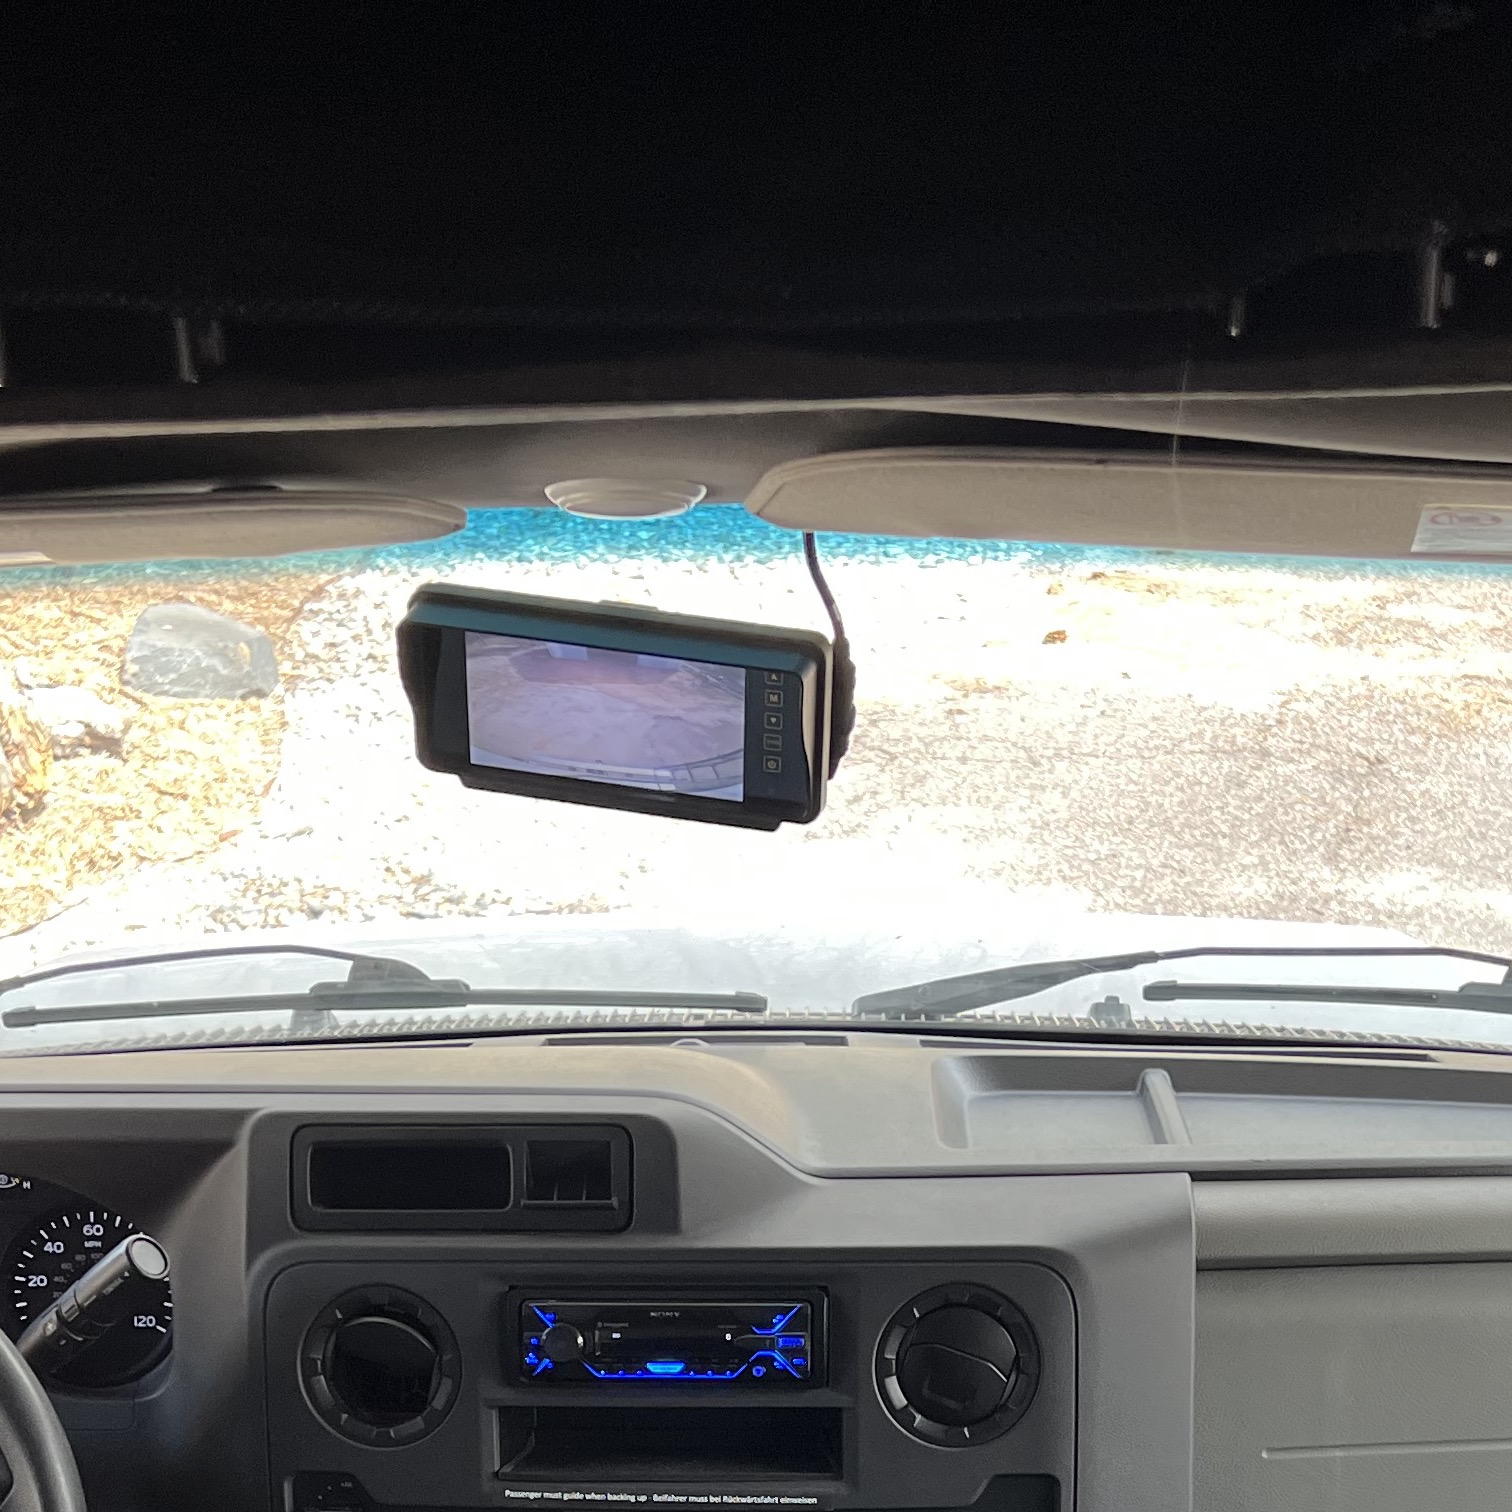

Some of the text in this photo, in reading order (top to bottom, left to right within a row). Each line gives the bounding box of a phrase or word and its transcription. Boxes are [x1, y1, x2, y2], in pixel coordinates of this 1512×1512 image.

[83, 1224, 104, 1236] 60
[43, 1242, 64, 1254] 40
[27, 1275, 48, 1287] 20
[133, 1316, 156, 1327] 120
[504, 1489, 542, 1500] Passenger
[543, 1491, 563, 1499] must
[563, 1491, 584, 1501] guide
[584, 1492, 606, 1500] when
[607, 1492, 636, 1503] backing
[636, 1494, 648, 1503] up
[688, 1495, 708, 1503] muss
[709, 1495, 722, 1503] bei
